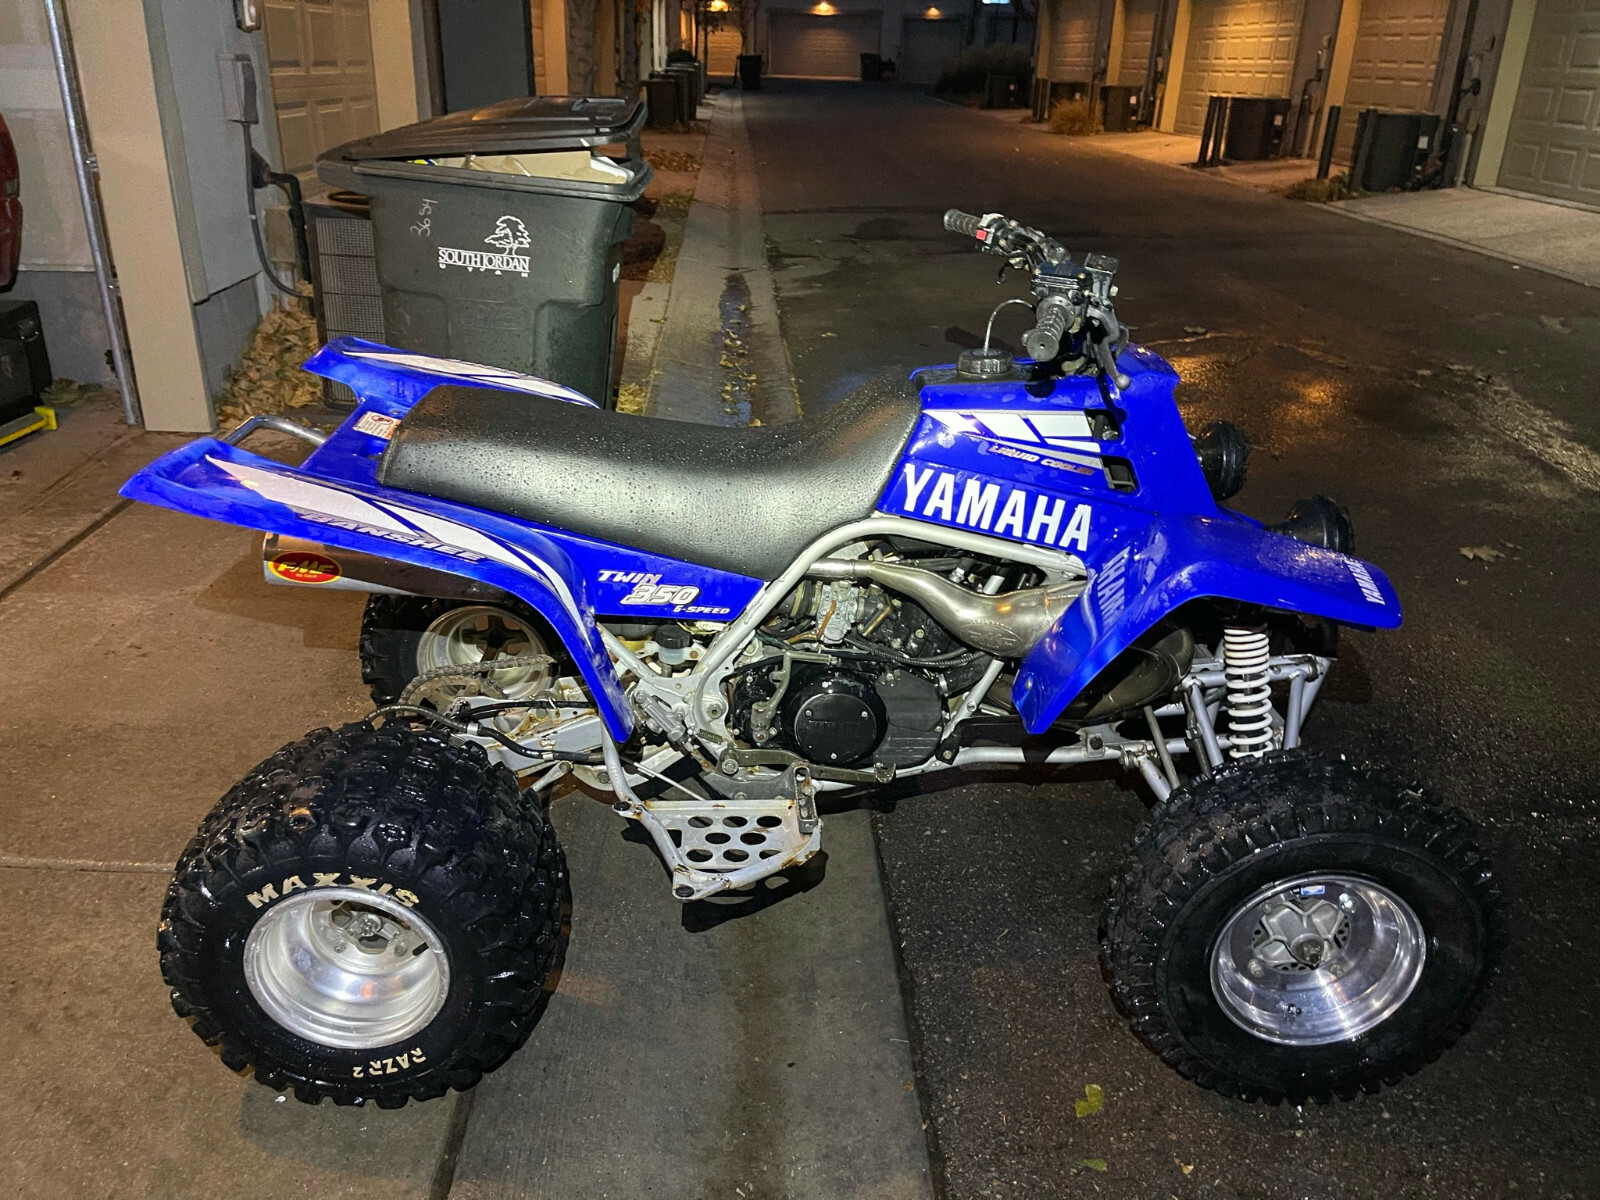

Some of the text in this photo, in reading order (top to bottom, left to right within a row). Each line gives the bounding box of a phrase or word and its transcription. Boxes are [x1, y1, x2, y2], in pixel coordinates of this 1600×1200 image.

[438, 249, 530, 272] SOUTH JORDAN
[903, 463, 1092, 552] YAMAHA
[299, 511, 486, 562] BANSHEE
[277, 560, 335, 574] FMF
[598, 570, 662, 585] TWIN
[620, 584, 701, 606] 350
[673, 604, 730, 615] 6-SPEED
[246, 872, 420, 909] MAXXIS
[352, 1047, 427, 1078] RAZR 2
